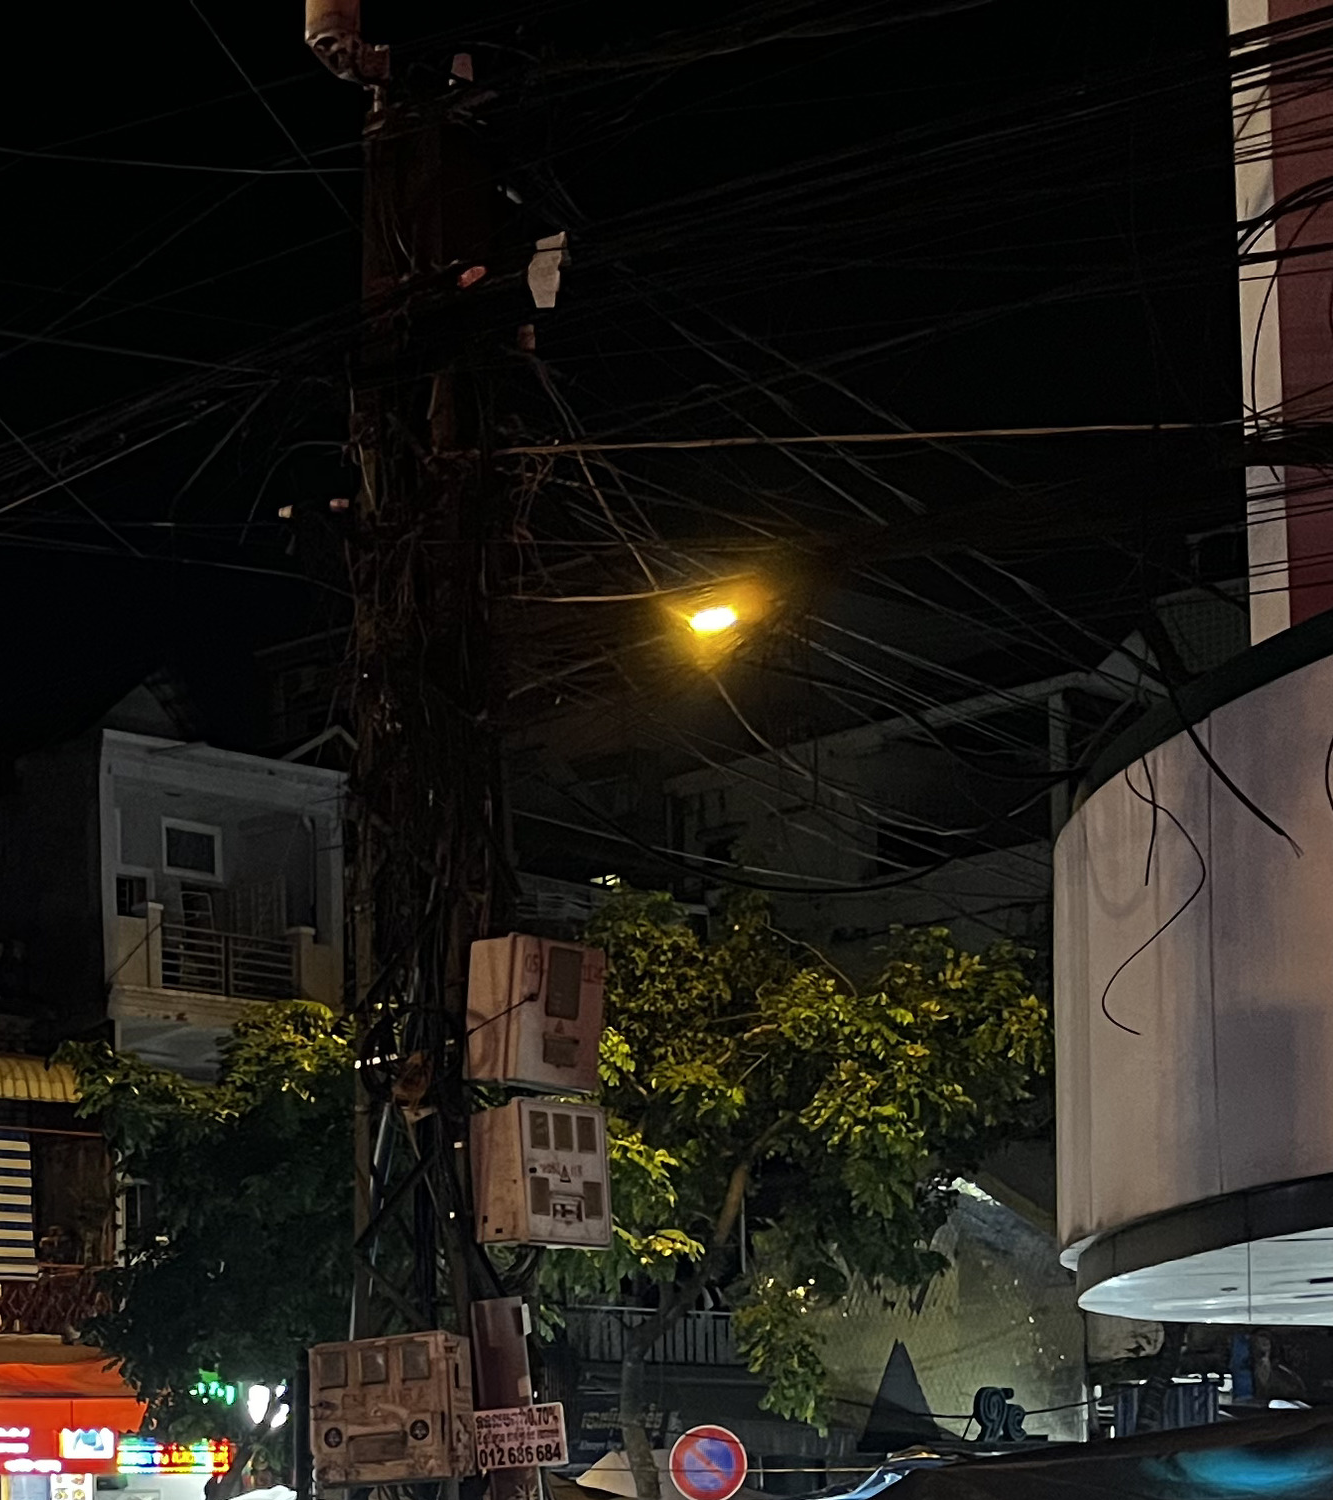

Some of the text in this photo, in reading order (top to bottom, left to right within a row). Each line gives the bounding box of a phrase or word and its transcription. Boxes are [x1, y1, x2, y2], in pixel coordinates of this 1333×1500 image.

[479, 1442, 562, 1467] 012 686 684
